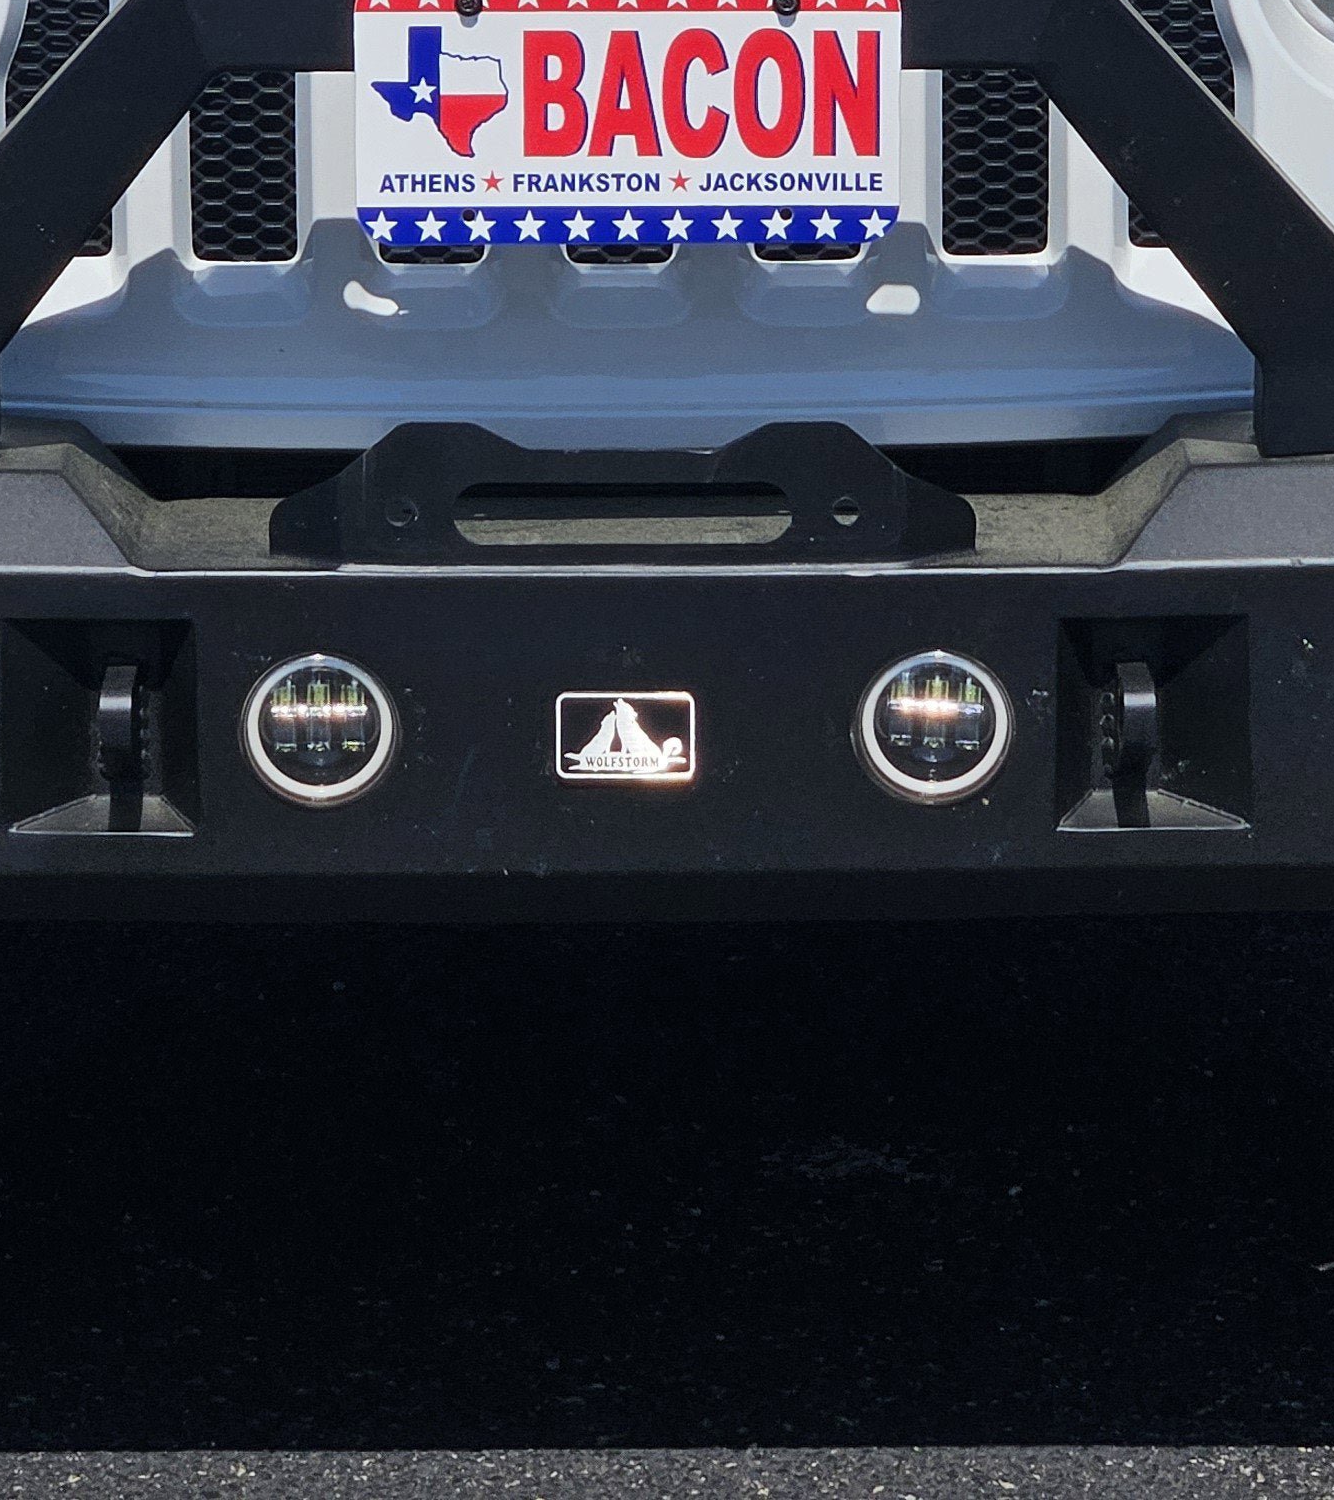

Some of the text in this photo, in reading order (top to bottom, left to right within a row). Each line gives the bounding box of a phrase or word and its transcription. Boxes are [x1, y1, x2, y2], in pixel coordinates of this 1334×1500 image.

[523, 28, 881, 158] BACON
[379, 172, 883, 193] ATHENS FRANKSTON JACKSONVILLE
[586, 756, 659, 768] WOLFSTORM
